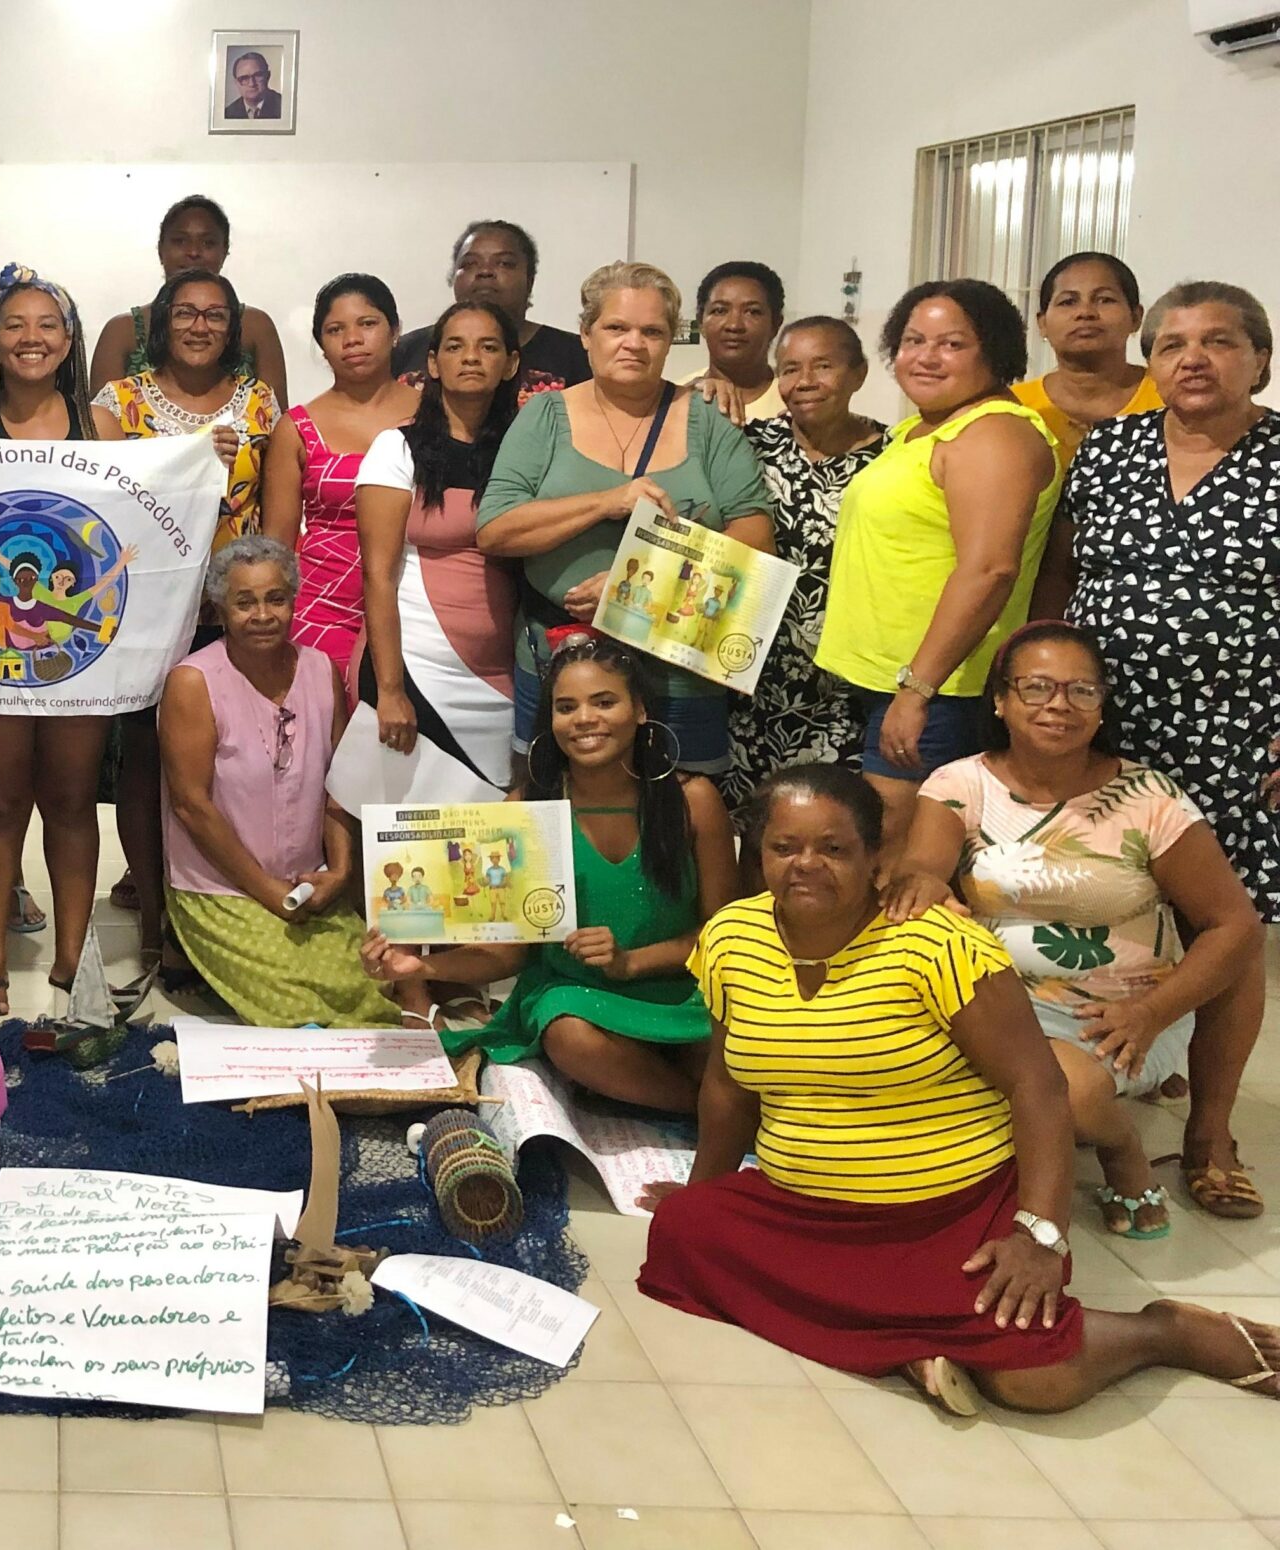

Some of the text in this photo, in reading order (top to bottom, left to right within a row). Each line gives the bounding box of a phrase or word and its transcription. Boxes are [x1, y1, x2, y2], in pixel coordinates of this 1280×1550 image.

[61, 450, 101, 477] das
[103, 465, 193, 558] Pescadoras
[720, 645, 753, 661] JUSTA
[49, 695, 116, 708] construindo
[397, 810, 440, 821] DIREITOS
[379, 828, 465, 841] RESPONSABILIDADES
[526, 901, 562, 915] JUSTA
[135, 1196, 192, 1213] Norte
[179, 1241, 204, 1250] ao
[86, 1269, 124, 1290] das
[58, 1311, 76, 1325] e
[82, 1303, 210, 1328] Vereadores
[218, 1310, 243, 1324] e
[84, 1359, 105, 1373] os
[111, 1359, 160, 1375] seus
[164, 1350, 255, 1381] próprios
